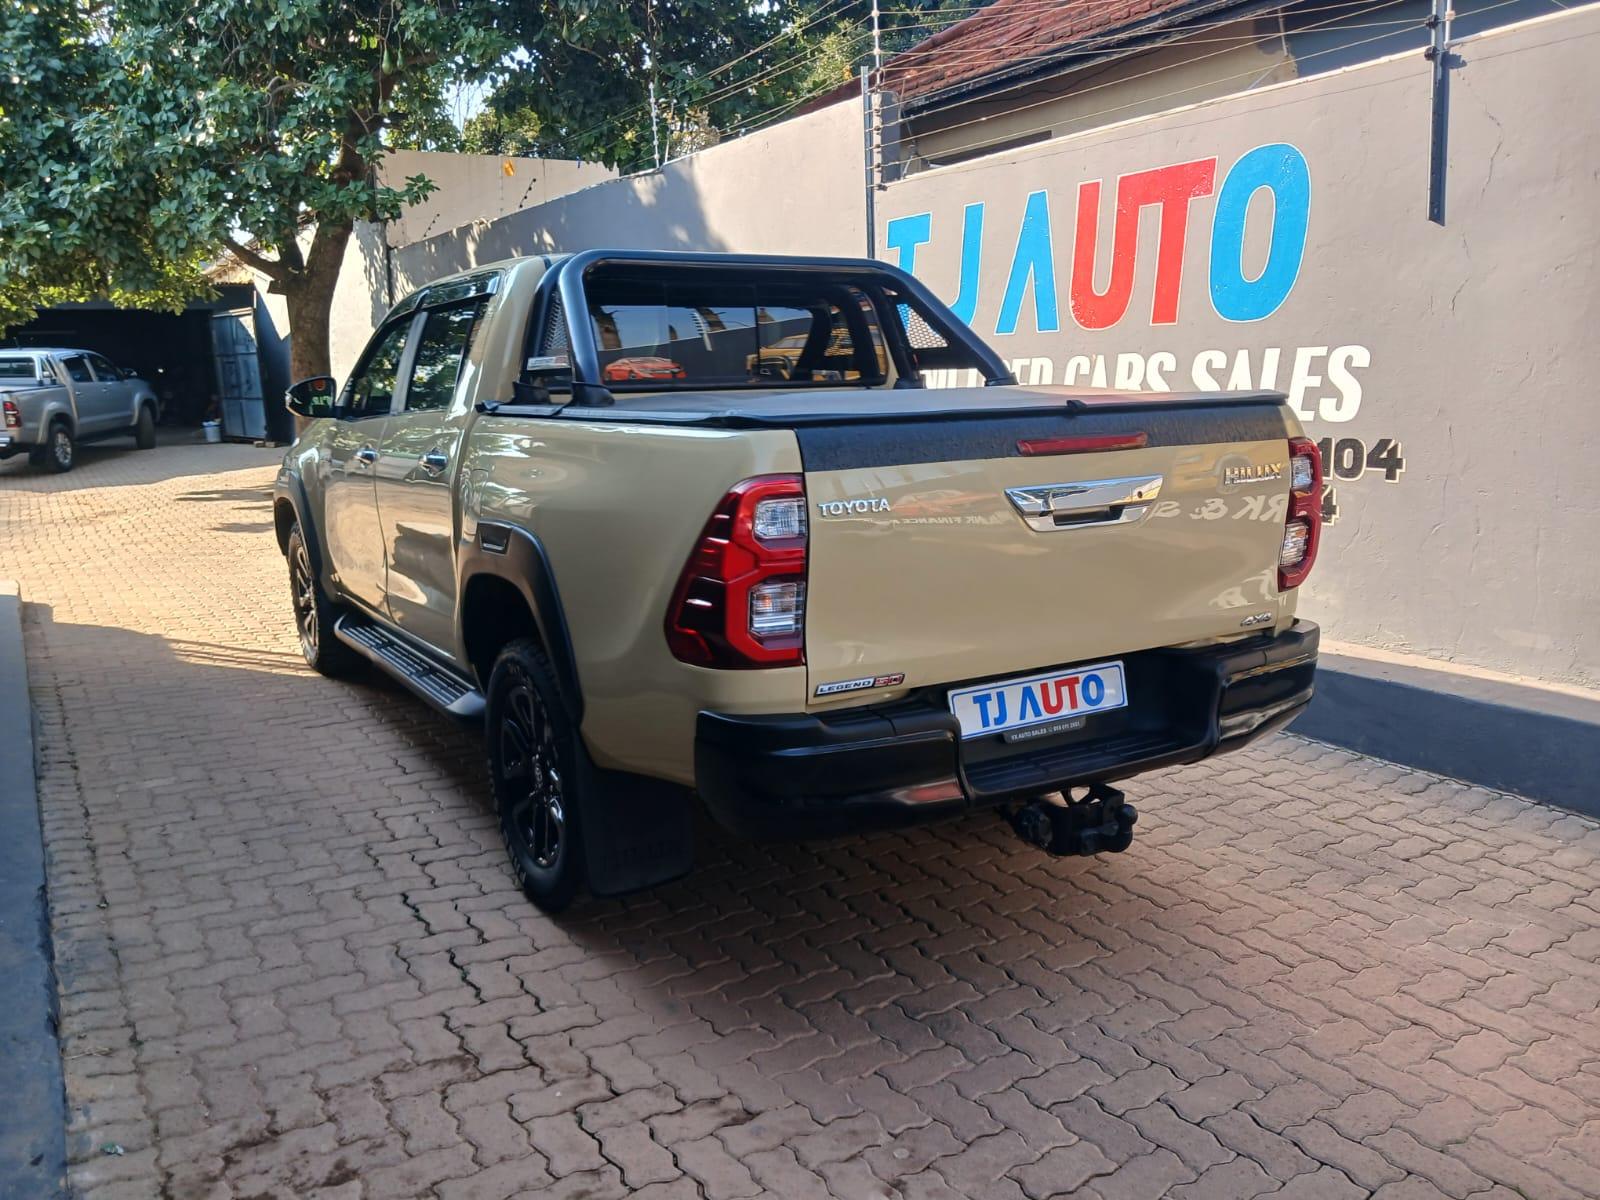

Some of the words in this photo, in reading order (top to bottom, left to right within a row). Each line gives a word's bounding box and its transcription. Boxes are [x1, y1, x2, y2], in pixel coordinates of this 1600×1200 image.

[886, 202, 985, 329] TJ
[994, 142, 1312, 335] AUTO
[1191, 344, 1371, 423] SALES
[1224, 463, 1281, 485] HILUX
[817, 498, 891, 517] TOYOTA
[819, 680, 871, 693] LEGEND
[973, 690, 1008, 729] TJ
[1020, 673, 1105, 721] AUTO
